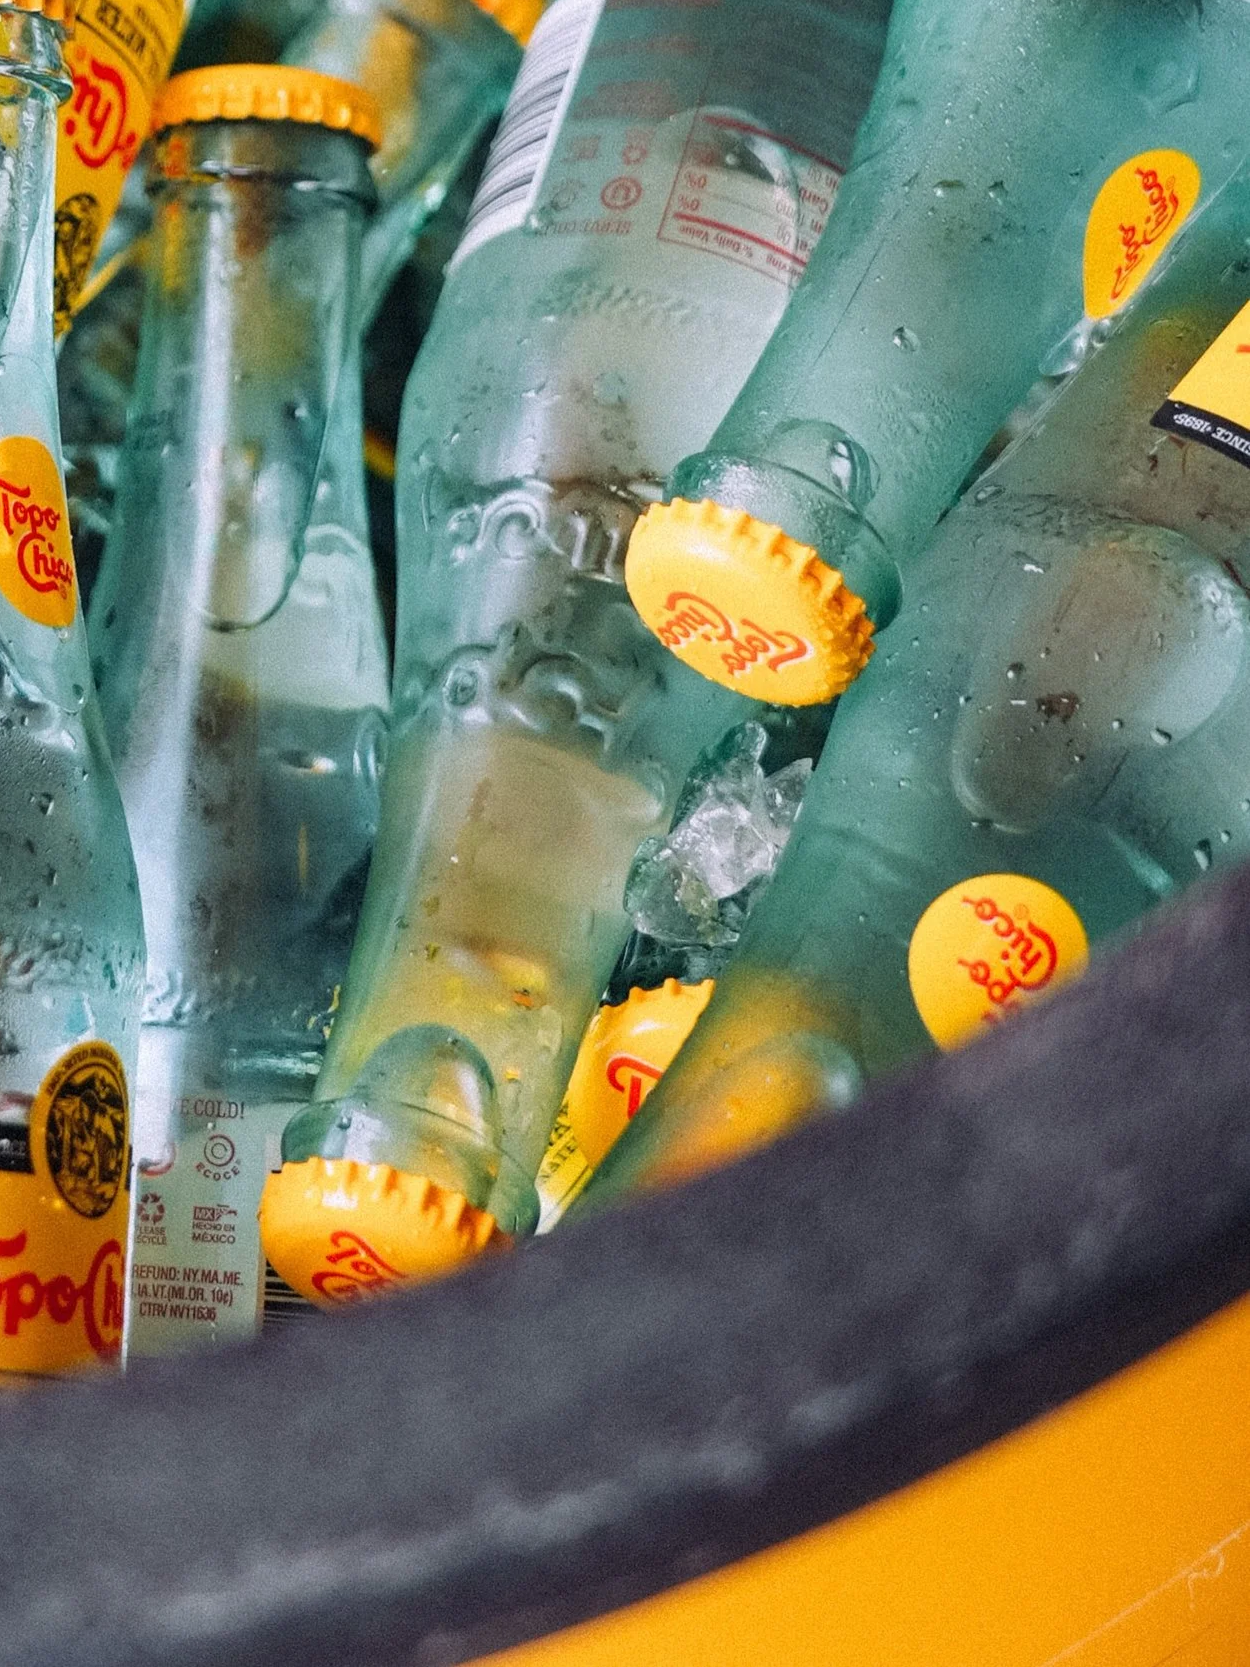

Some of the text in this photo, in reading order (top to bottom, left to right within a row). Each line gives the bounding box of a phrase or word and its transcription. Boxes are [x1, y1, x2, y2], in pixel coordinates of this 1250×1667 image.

[658, 591, 810, 676] Topo Chico
[194, 1098, 245, 1119] COLD!
[192, 1221, 219, 1232] HECHO
